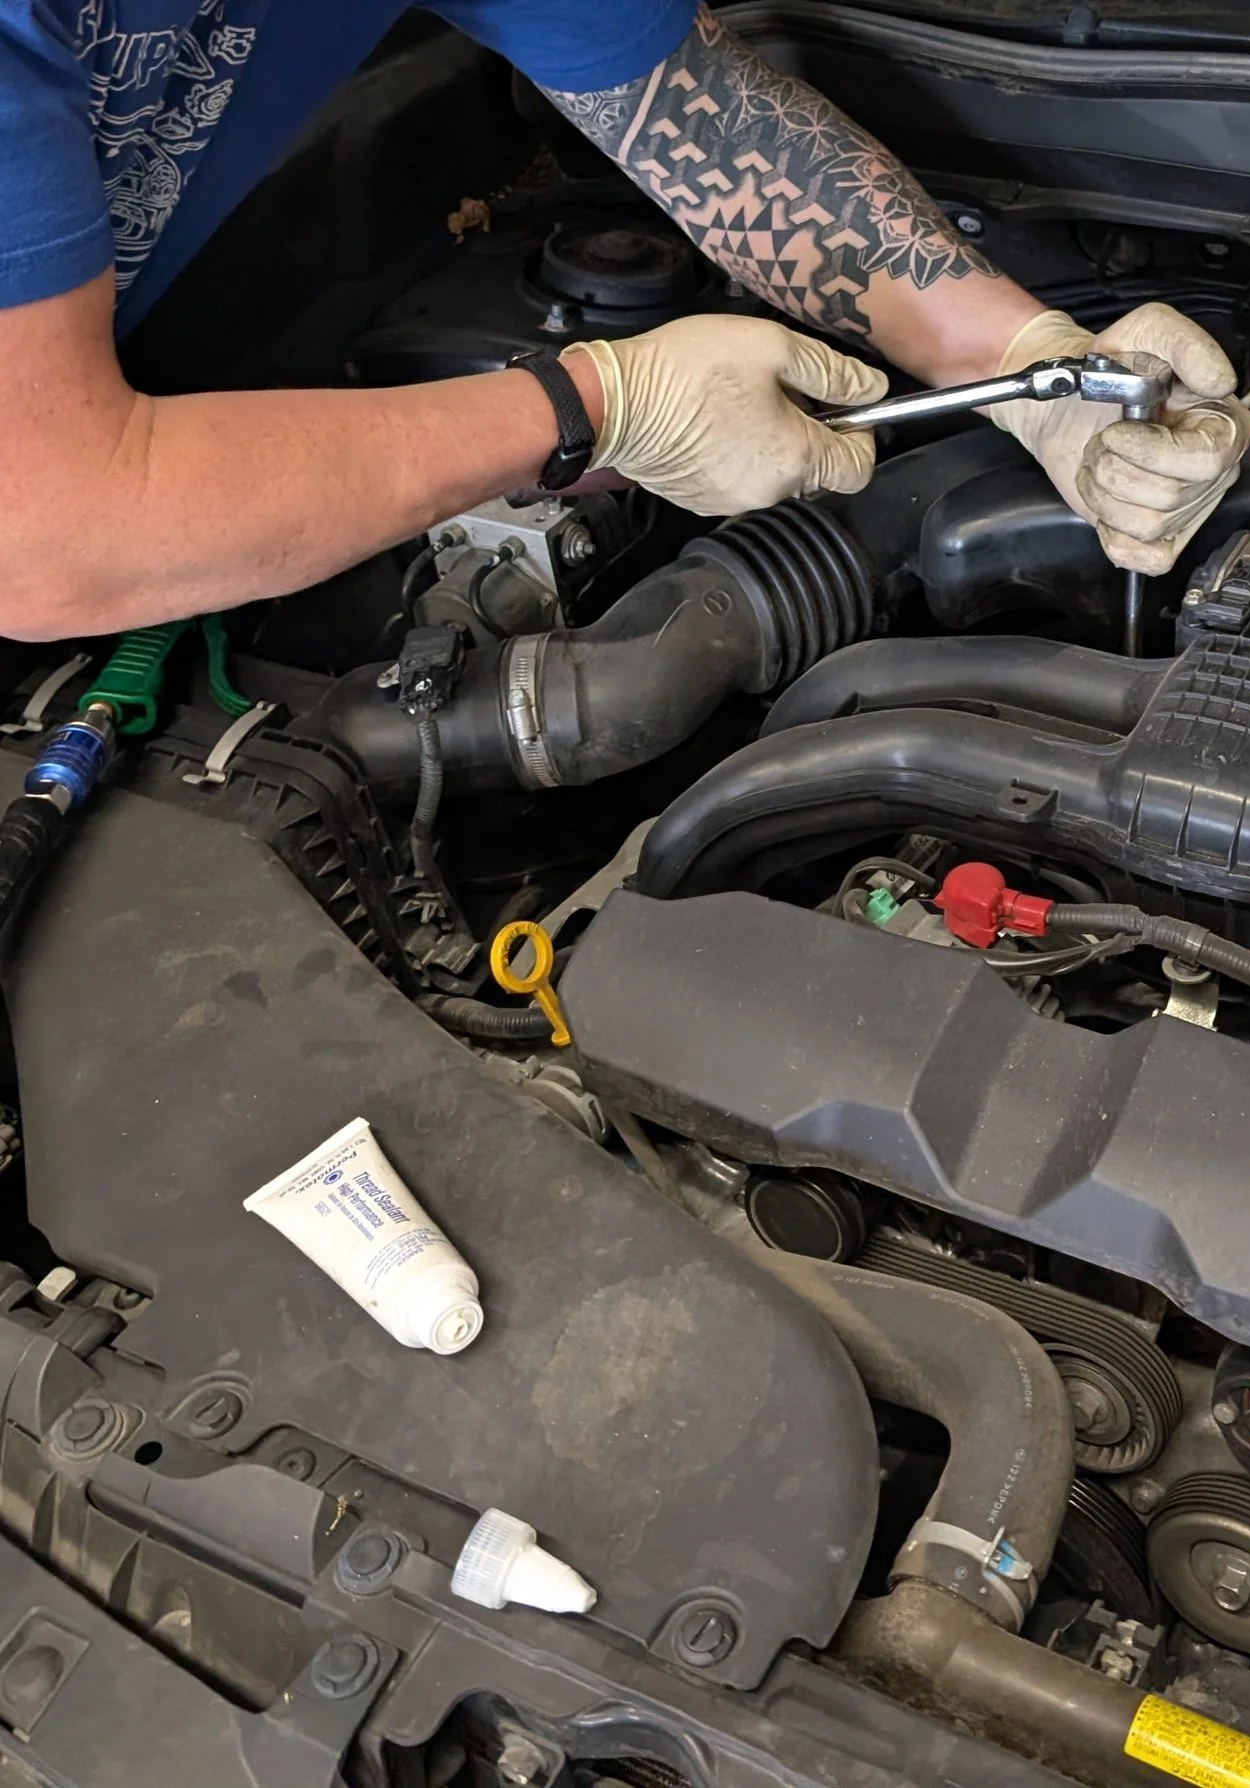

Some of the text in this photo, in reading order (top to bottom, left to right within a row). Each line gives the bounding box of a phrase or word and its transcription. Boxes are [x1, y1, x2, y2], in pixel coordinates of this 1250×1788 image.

[336, 1181, 355, 1198] High
[347, 1192, 384, 1228] Performance
[352, 1170, 385, 1197] Thread
[373, 1192, 410, 1225] Sealant
